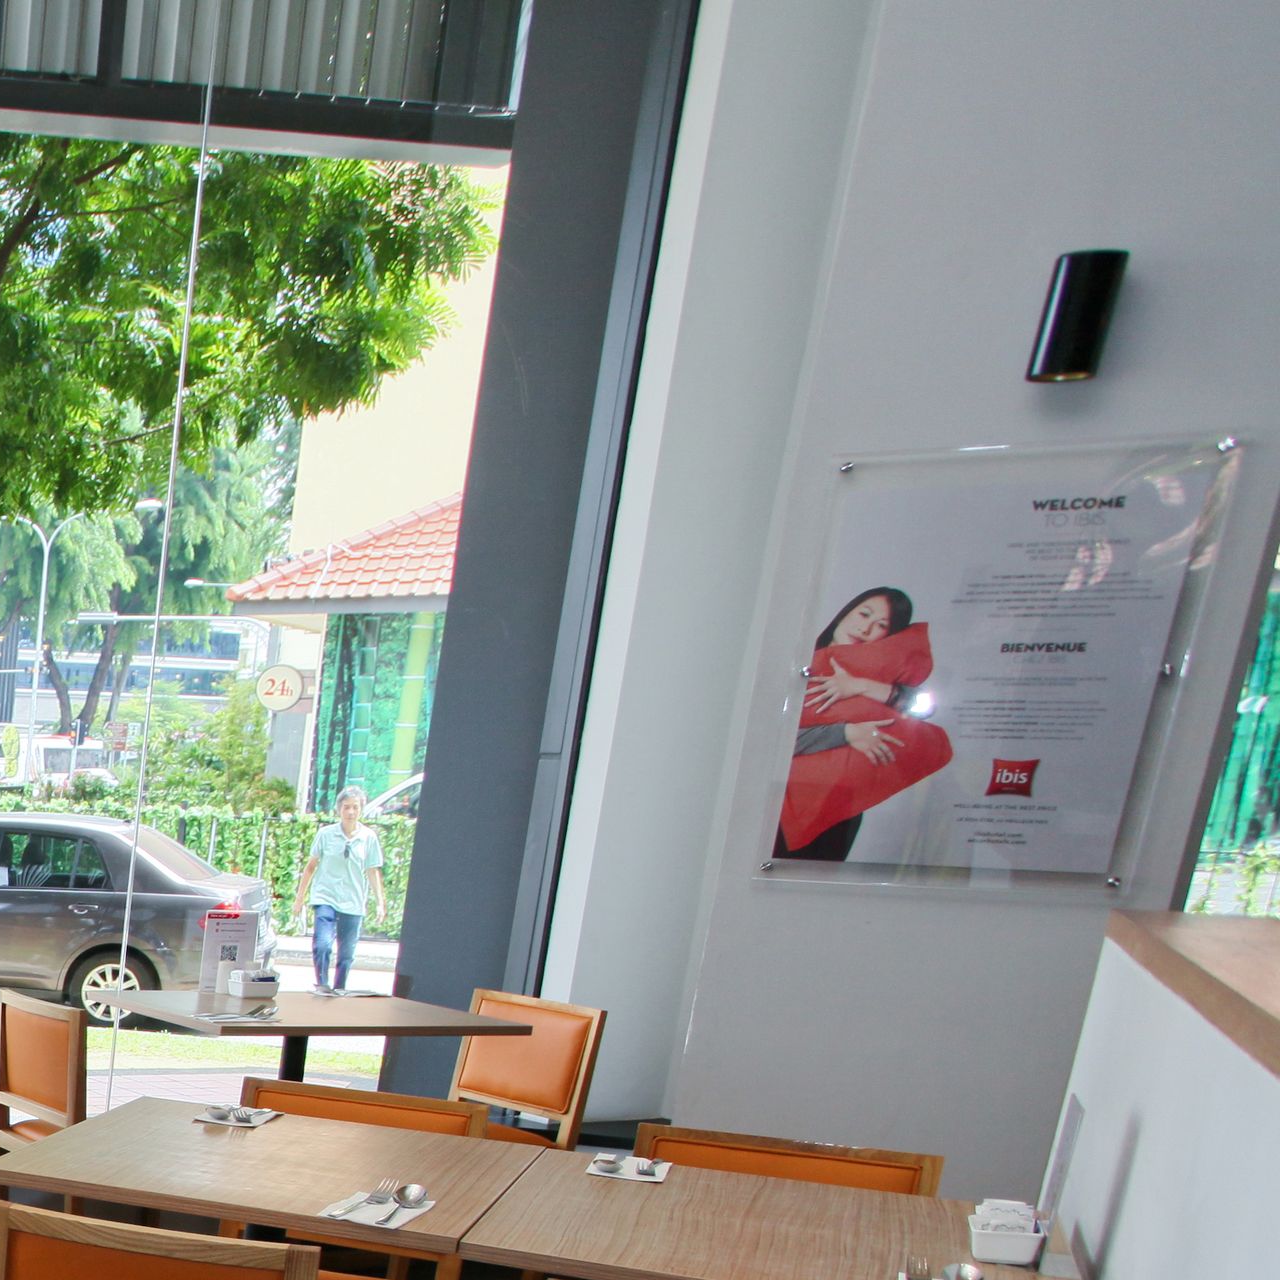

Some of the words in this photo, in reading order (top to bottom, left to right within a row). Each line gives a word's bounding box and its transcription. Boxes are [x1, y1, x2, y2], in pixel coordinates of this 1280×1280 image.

[1032, 496, 1126, 511] WELCOME
[1000, 642, 1088, 653] BIENVENUE
[995, 768, 1028, 784] ibis
